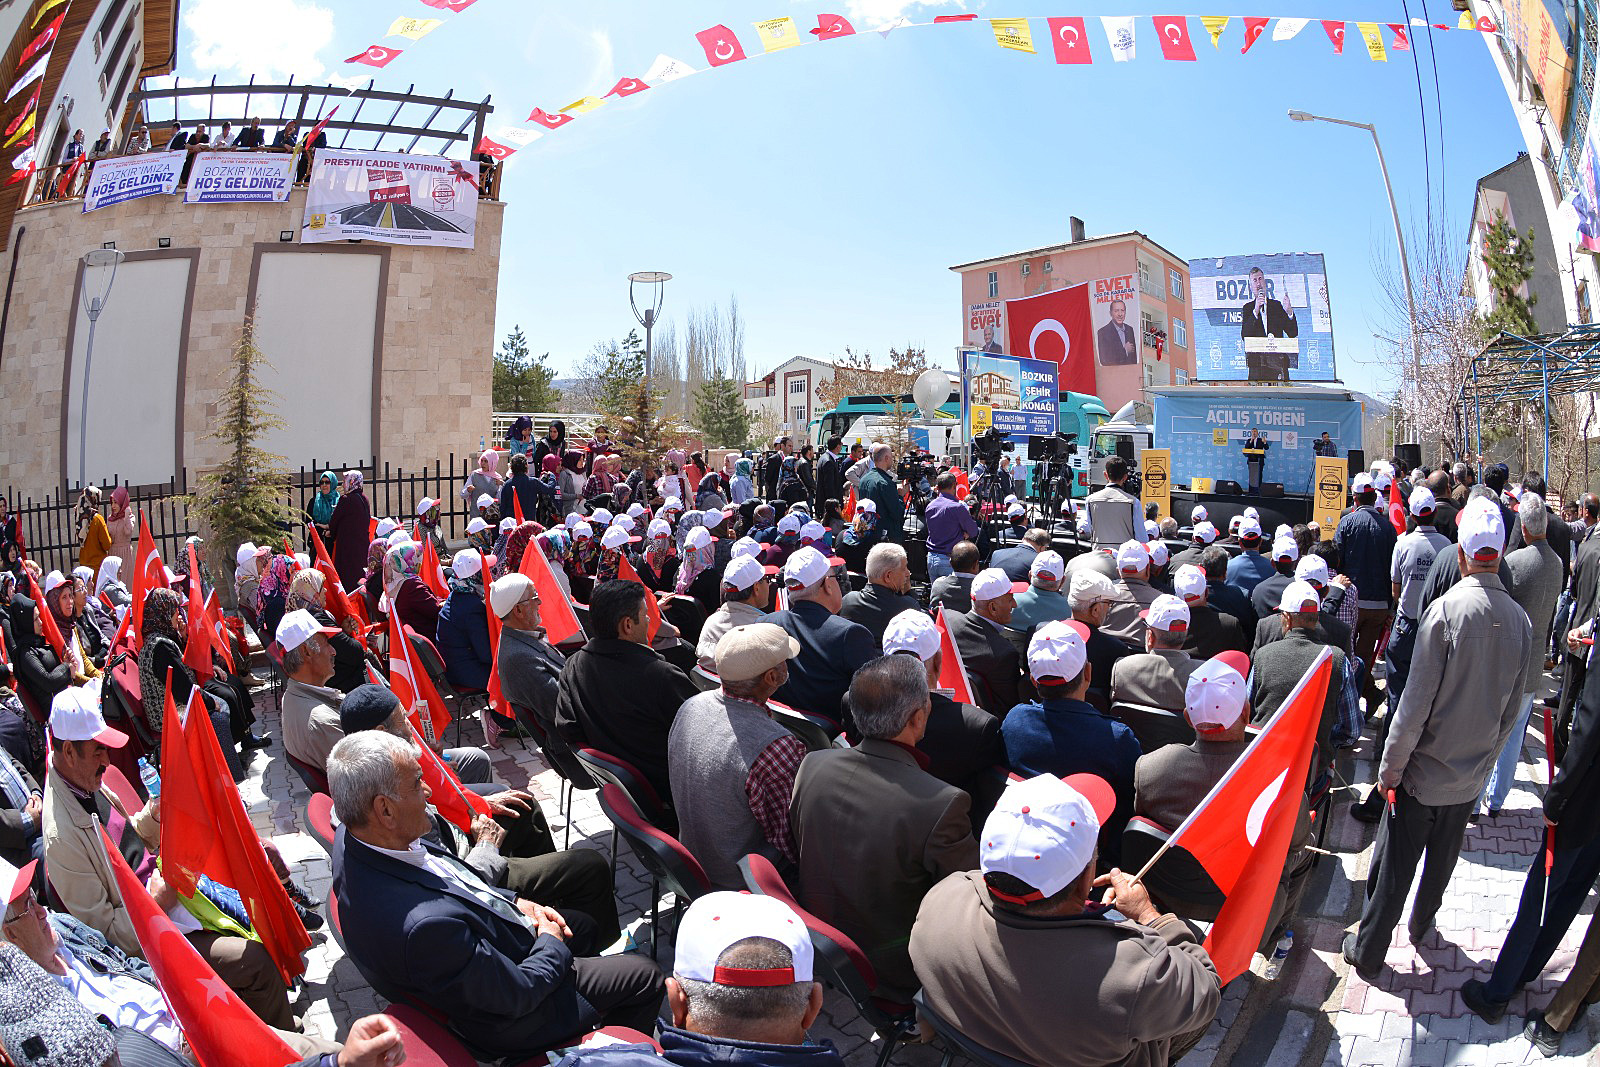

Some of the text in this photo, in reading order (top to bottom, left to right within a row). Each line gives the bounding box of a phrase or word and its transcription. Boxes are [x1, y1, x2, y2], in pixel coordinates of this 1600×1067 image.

[366, 159, 400, 168] CADDE
[194, 177, 222, 191] HOŞ
[1096, 275, 1132, 293] EVET
[1216, 279, 1276, 301] BOZR
[971, 309, 1001, 330] evet
[1021, 371, 1054, 383] BOZKIR
[1025, 385, 1051, 397] ŞEHİR
[1022, 400, 1055, 412] KONAĞI
[1206, 409, 1250, 427] AÇILIŞ
